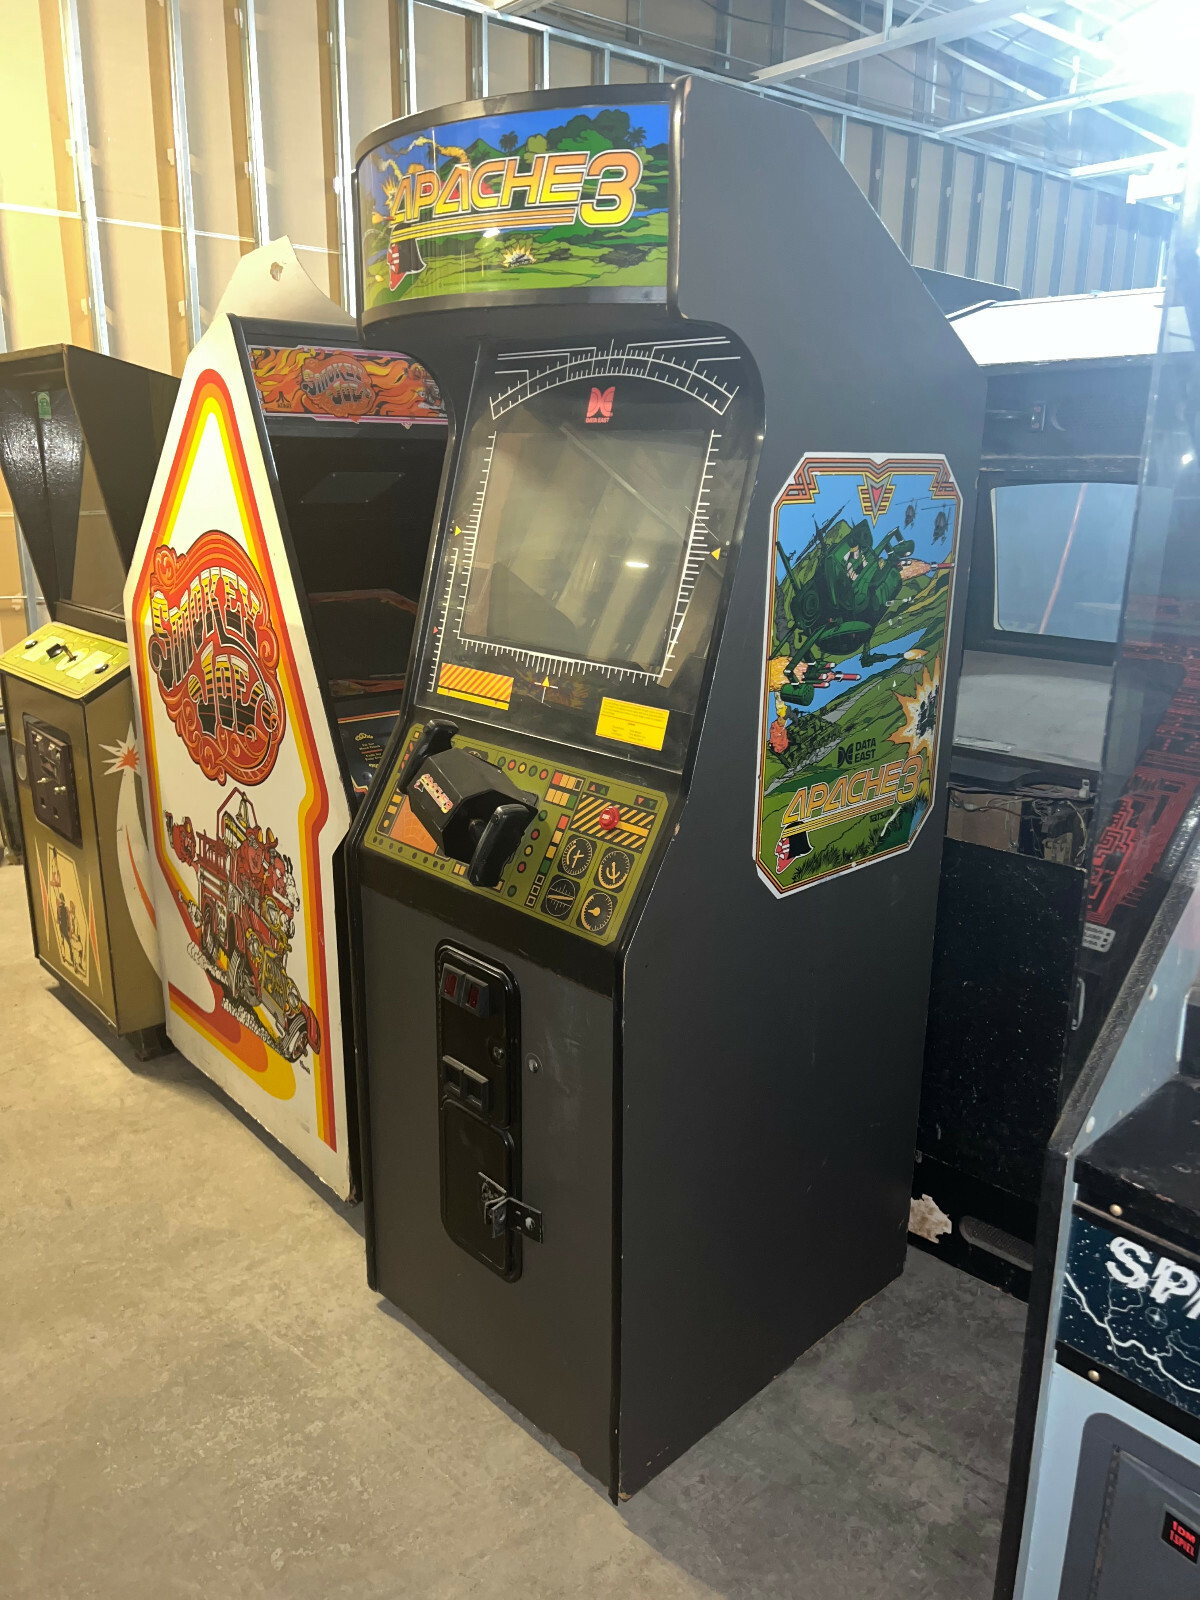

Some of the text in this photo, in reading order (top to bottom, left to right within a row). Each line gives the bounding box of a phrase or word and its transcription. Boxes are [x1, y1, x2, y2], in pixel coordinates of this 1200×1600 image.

[149, 566, 261, 692] SMOKEY
[855, 737, 877, 752] DATA
[854, 748, 876, 764] EAST
